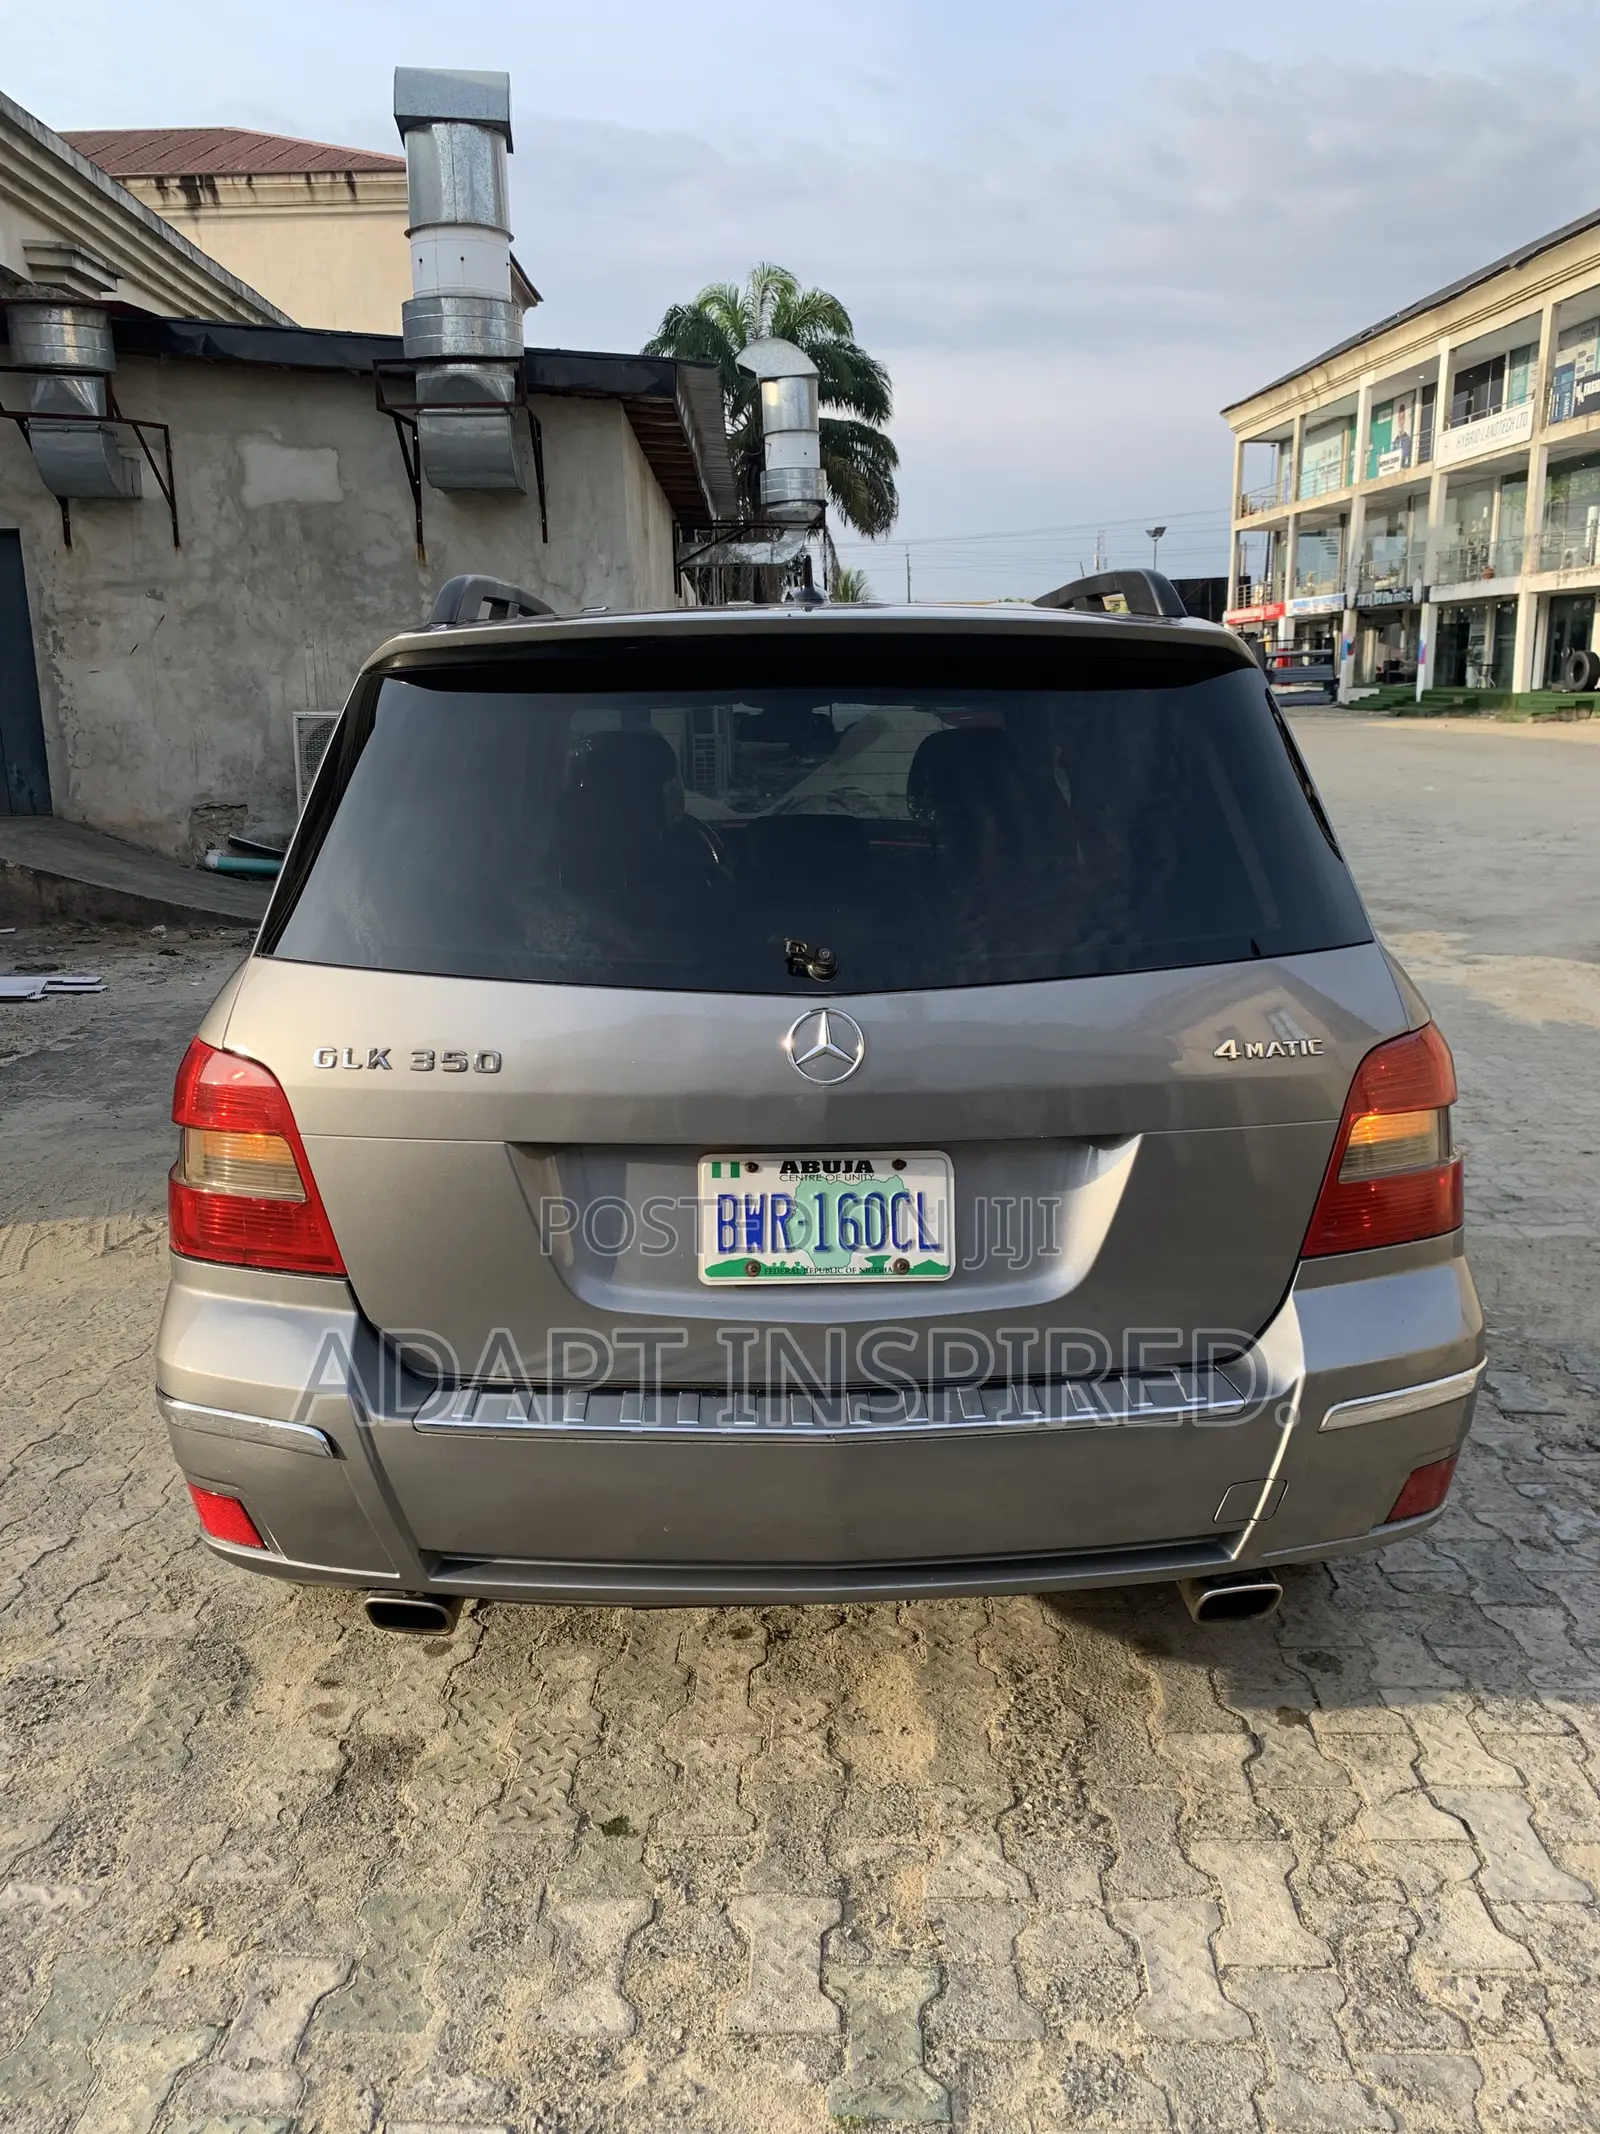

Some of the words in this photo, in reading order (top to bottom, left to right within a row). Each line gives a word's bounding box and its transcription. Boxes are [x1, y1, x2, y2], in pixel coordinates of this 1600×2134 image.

[312, 1047, 393, 1070] GLK
[410, 1049, 502, 1074] 350
[780, 1160, 875, 1174] ABUJA
[780, 1173, 822, 1182] CENTRE
[825, 1173, 842, 1181] OF
[844, 1173, 875, 1181] UNITY
[764, 1266, 801, 1275] FEDERAL
[803, 1266, 843, 1275] REPUBLIC
[845, 1265, 857, 1274] OF
[859, 1265, 894, 1274] NIGERIA
